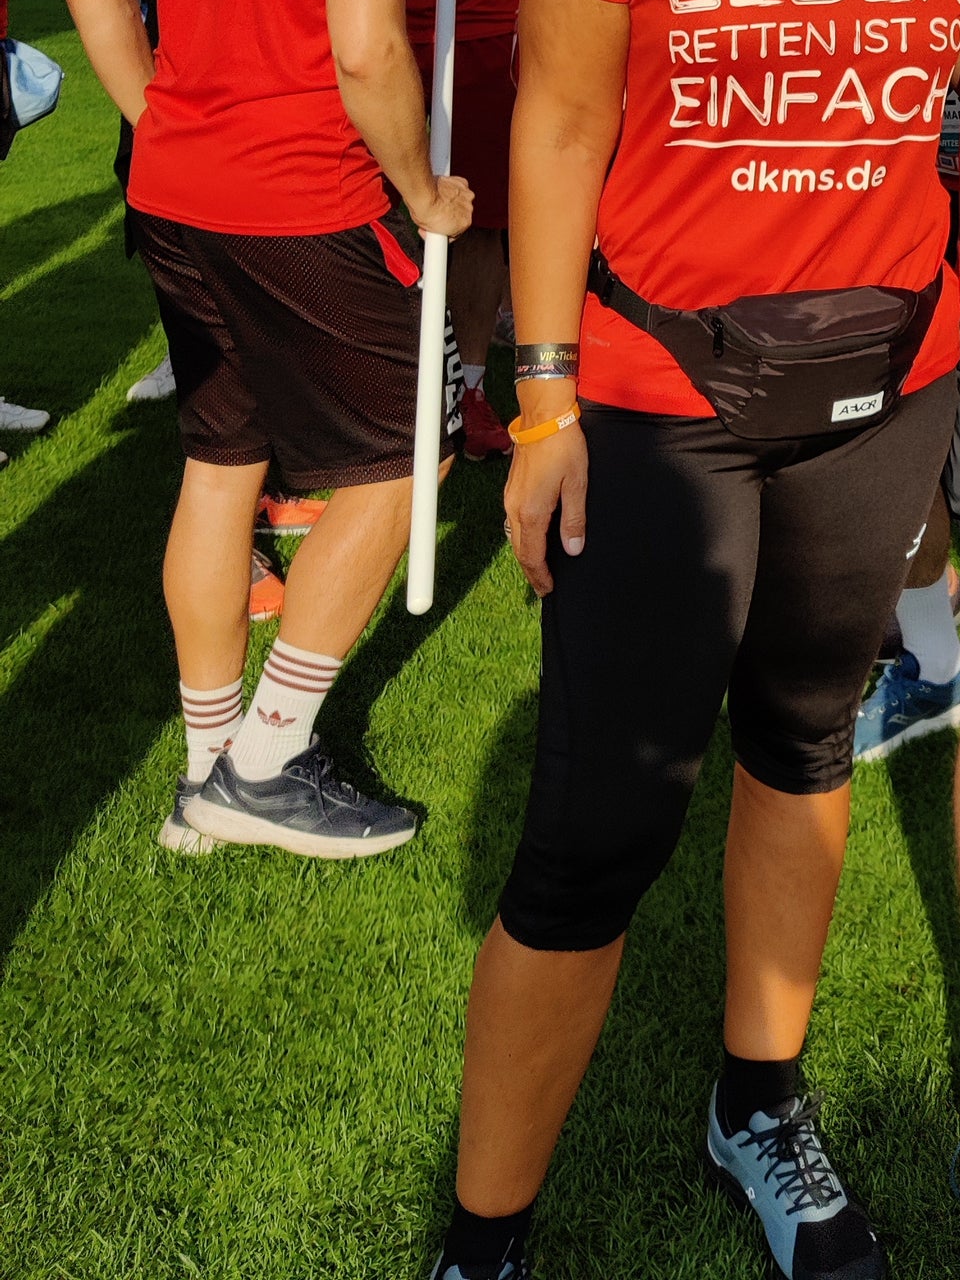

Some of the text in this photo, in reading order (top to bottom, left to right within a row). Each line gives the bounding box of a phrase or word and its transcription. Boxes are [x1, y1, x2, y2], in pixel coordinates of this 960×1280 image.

[668, 19, 836, 64] RETTEN
[853, 17, 917, 55] IST
[670, 65, 955, 128] EINFACH
[731, 159, 887, 193] dkms.de
